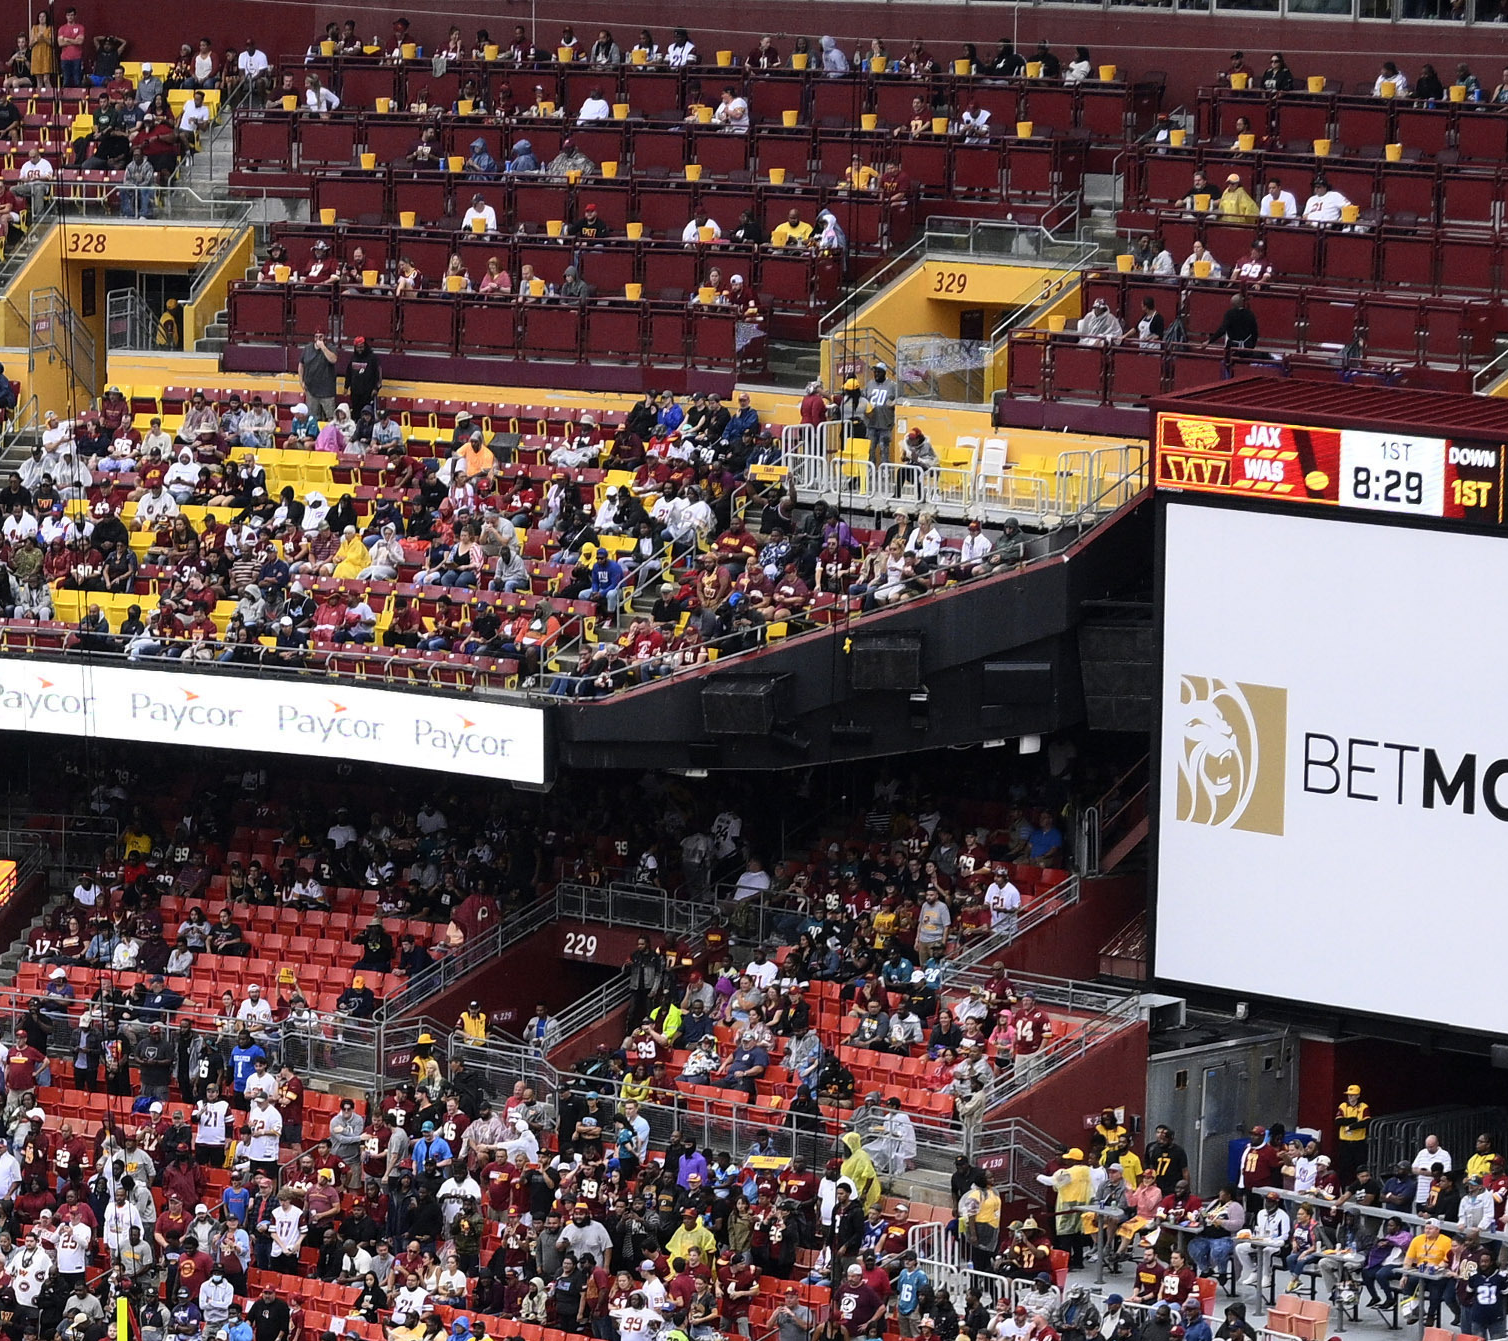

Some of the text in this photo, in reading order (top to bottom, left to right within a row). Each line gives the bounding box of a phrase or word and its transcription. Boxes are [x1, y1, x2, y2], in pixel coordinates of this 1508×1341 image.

[69, 233, 107, 253] 328
[934, 272, 968, 295] 329
[1245, 425, 1282, 450] JAX
[1379, 441, 1413, 462] 1ST
[1449, 448, 1496, 469] DOWN
[1244, 458, 1284, 482] WAS
[1352, 467, 1423, 506] 8:29
[1453, 481, 1494, 509] 1ST
[133, 694, 239, 727] Paycor
[280, 706, 384, 741] Paycor
[415, 719, 513, 757] Paycor
[563, 932, 597, 957] 229
[1478, 1286, 1496, 1304] 21
